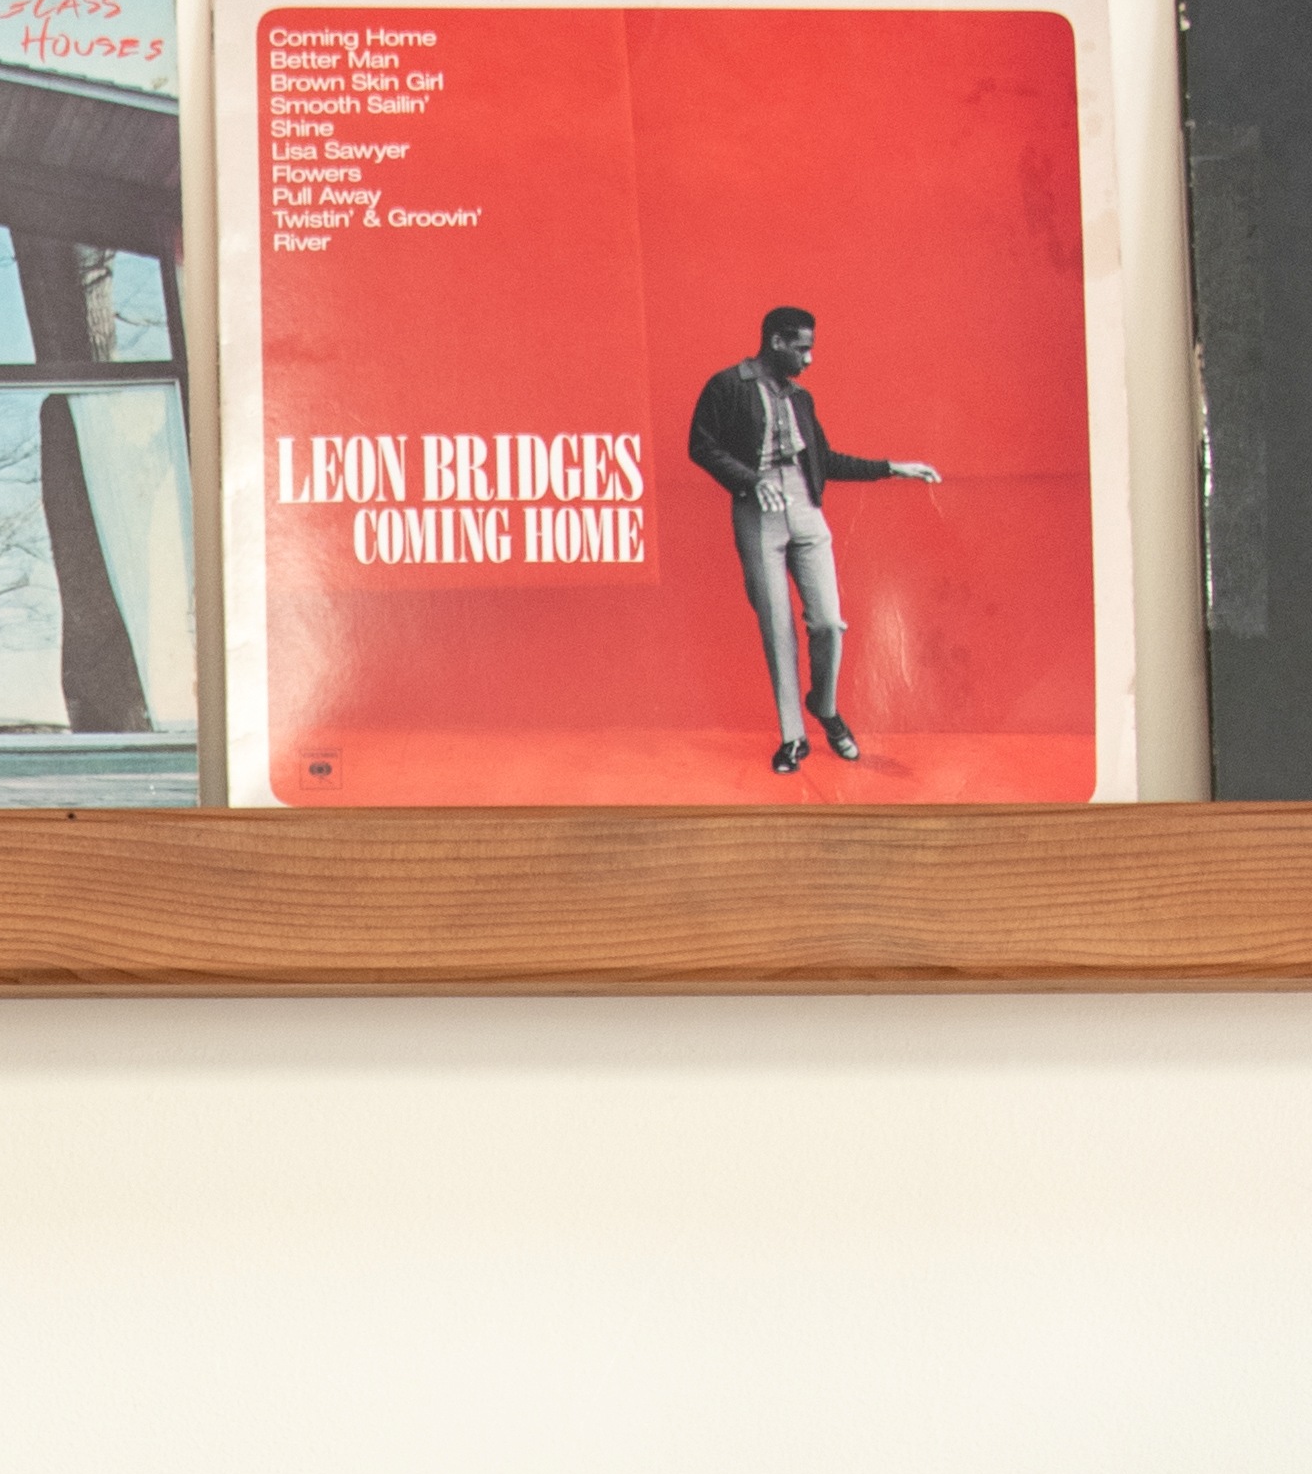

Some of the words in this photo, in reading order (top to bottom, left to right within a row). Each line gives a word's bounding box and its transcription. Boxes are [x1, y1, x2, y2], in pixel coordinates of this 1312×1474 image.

[21, 16, 164, 63] HOUSES
[269, 28, 359, 50] Coming
[366, 28, 437, 46] Home
[270, 51, 341, 69] Better
[348, 50, 399, 69] Man
[270, 74, 345, 92] Brown
[351, 72, 399, 91] Skin
[406, 72, 444, 91] Girl
[270, 96, 360, 114] Smooth
[271, 119, 334, 138] Shine
[272, 142, 318, 160] Lisa
[324, 141, 410, 164] Sawyer
[272, 165, 362, 183] Flowers
[273, 187, 312, 206] Pull
[319, 187, 381, 210] Away
[363, 209, 381, 228] &
[274, 234, 331, 252] River
[277, 434, 408, 504] LEON
[421, 432, 644, 502] BRIDGES
[353, 507, 512, 565] COMING
[523, 507, 645, 564] HOME
